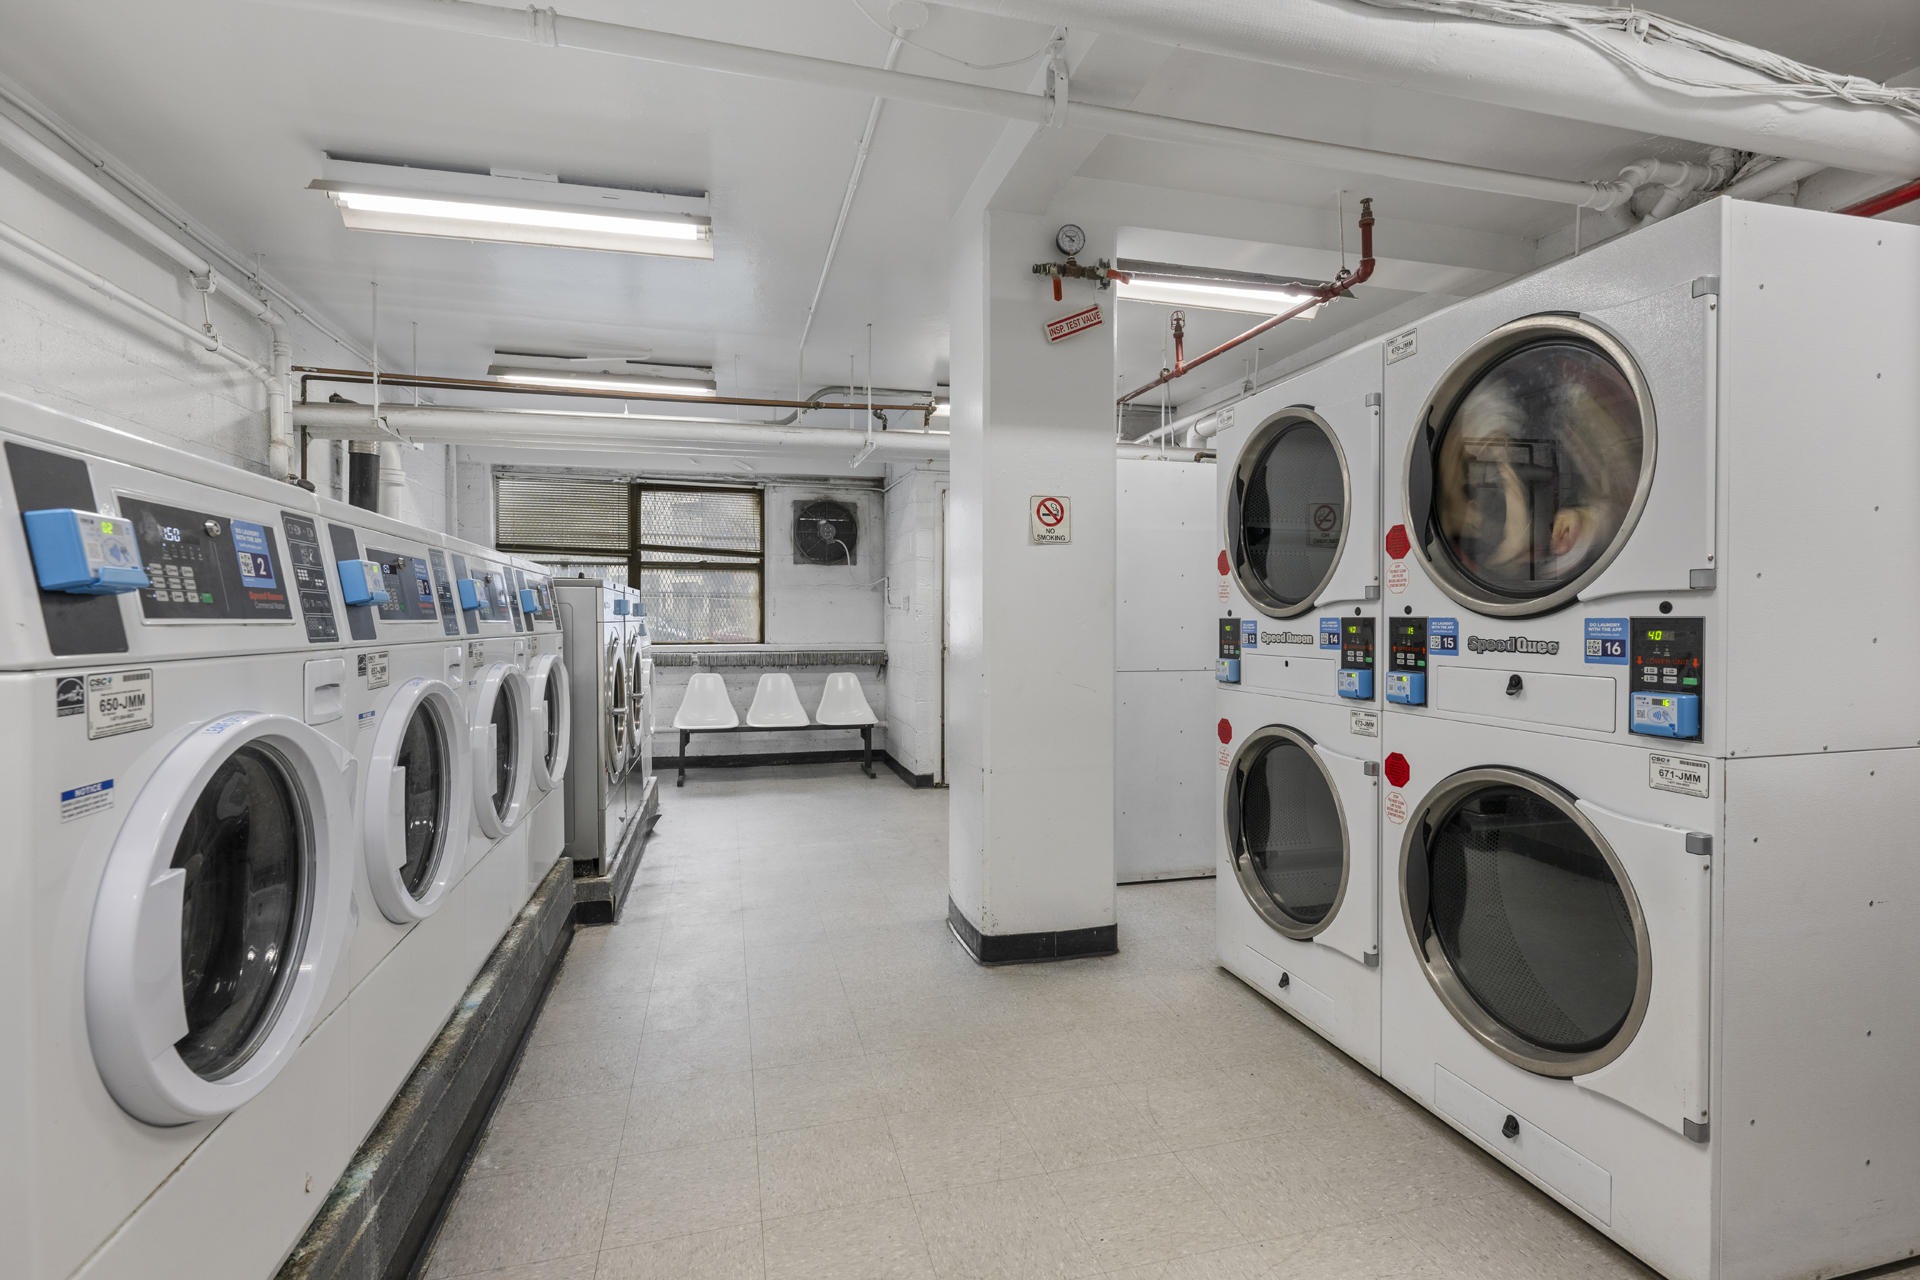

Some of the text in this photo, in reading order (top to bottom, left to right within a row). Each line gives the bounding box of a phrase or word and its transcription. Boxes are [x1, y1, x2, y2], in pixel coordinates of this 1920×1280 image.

[1048, 311, 1101, 336] INSP. TEST VALVE
[257, 558, 267, 575] 2
[249, 591, 284, 601] Speed Queen
[1249, 634, 1255, 643] 13
[1261, 631, 1314, 645] Speed Queen
[1330, 634, 1338, 644] 14
[1648, 630, 1662, 640] 40
[1443, 637, 1454, 648] 15
[1468, 636, 1516, 654] Speed
[1605, 642, 1621, 655] 16
[90, 678, 107, 686] CSC
[100, 693, 146, 712] 650-JMM
[1659, 769, 1701, 783] 671-JMM
[75, 783, 102, 797] NOTICE
